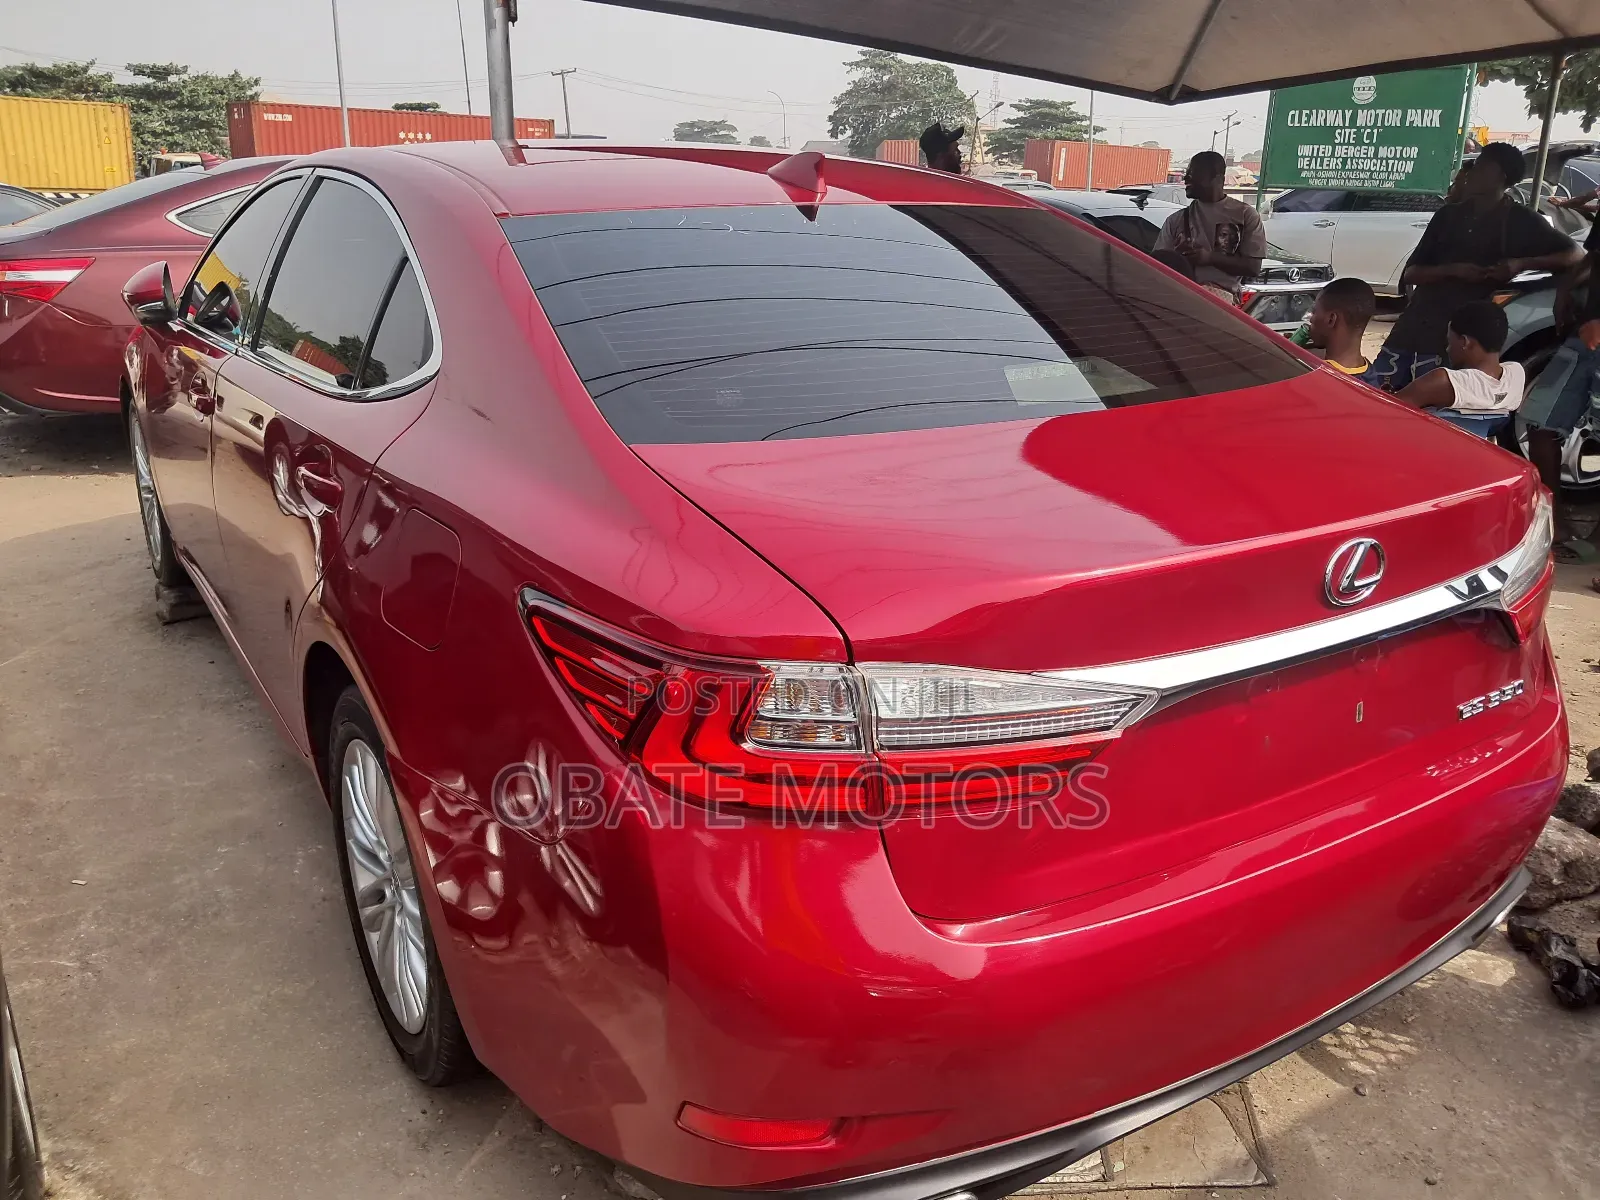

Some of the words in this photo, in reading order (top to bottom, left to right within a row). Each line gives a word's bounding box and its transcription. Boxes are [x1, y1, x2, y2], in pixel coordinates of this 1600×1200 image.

[1287, 109, 1353, 127] CLEARWAY
[1356, 109, 1402, 127] MOTOR
[1405, 109, 1442, 128] PARK
[1334, 128, 1357, 144] SITE
[1297, 145, 1332, 157] UNITED
[1335, 145, 1375, 158] BERGER
[1378, 146, 1419, 159] MOTOR
[1297, 157, 1342, 170] DEALERS
[1345, 158, 1415, 173] ASSOCIATION
[1379, 180, 1396, 188] LAGOS
[1457, 696, 1486, 720] ES
[1487, 679, 1524, 708] 350
